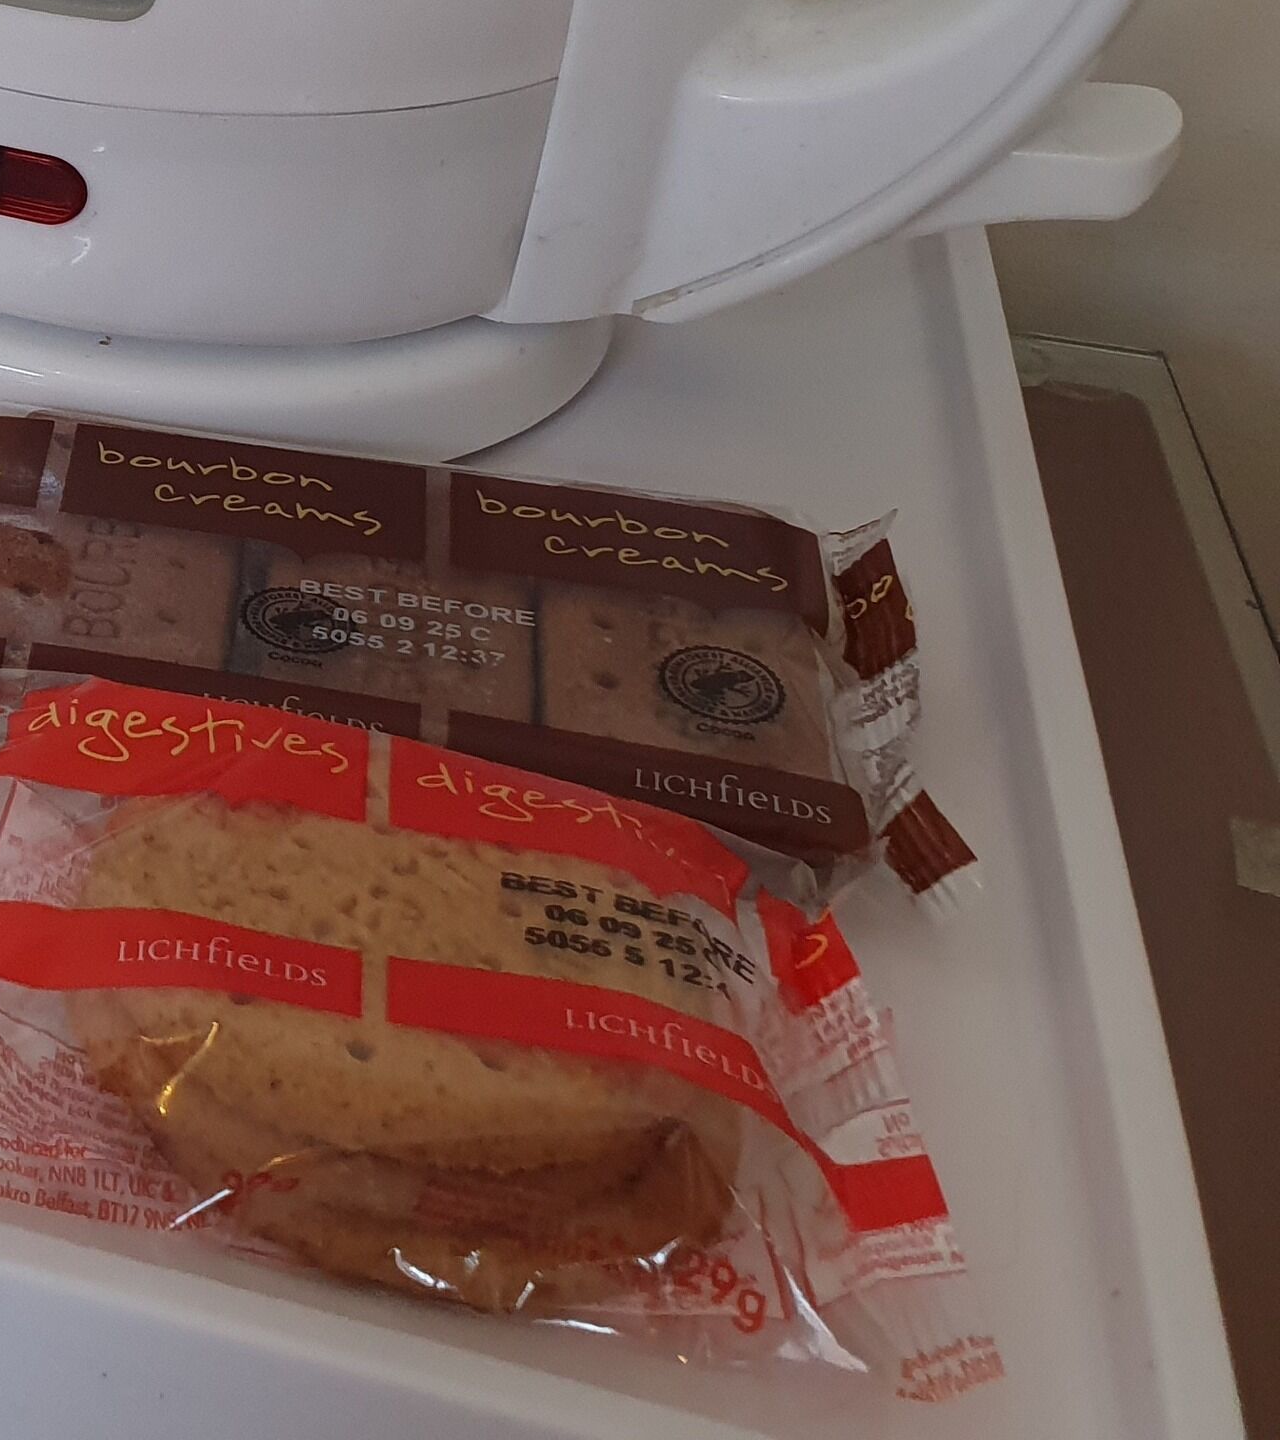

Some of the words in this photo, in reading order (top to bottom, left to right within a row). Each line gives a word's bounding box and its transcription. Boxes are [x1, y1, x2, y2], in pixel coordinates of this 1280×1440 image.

[97, 441, 333, 492] bourbon
[154, 483, 382, 536] creams
[476, 489, 730, 548] bourbon
[544, 534, 789, 593] creams
[299, 579, 388, 604] BEST
[397, 592, 536, 628] BEFORE
[332, 607, 369, 625] 06
[379, 613, 416, 632] 09
[426, 620, 462, 640] 25
[470, 626, 491, 642] C
[311, 625, 385, 649] 5055
[397, 639, 413, 655] 2
[28, 704, 350, 773] digestives
[500, 871, 605, 905] BEST
[544, 904, 589, 926] 06
[598, 916, 642, 940] 09
[652, 930, 697, 956] 25
[673, 1250, 767, 1335] 29g
